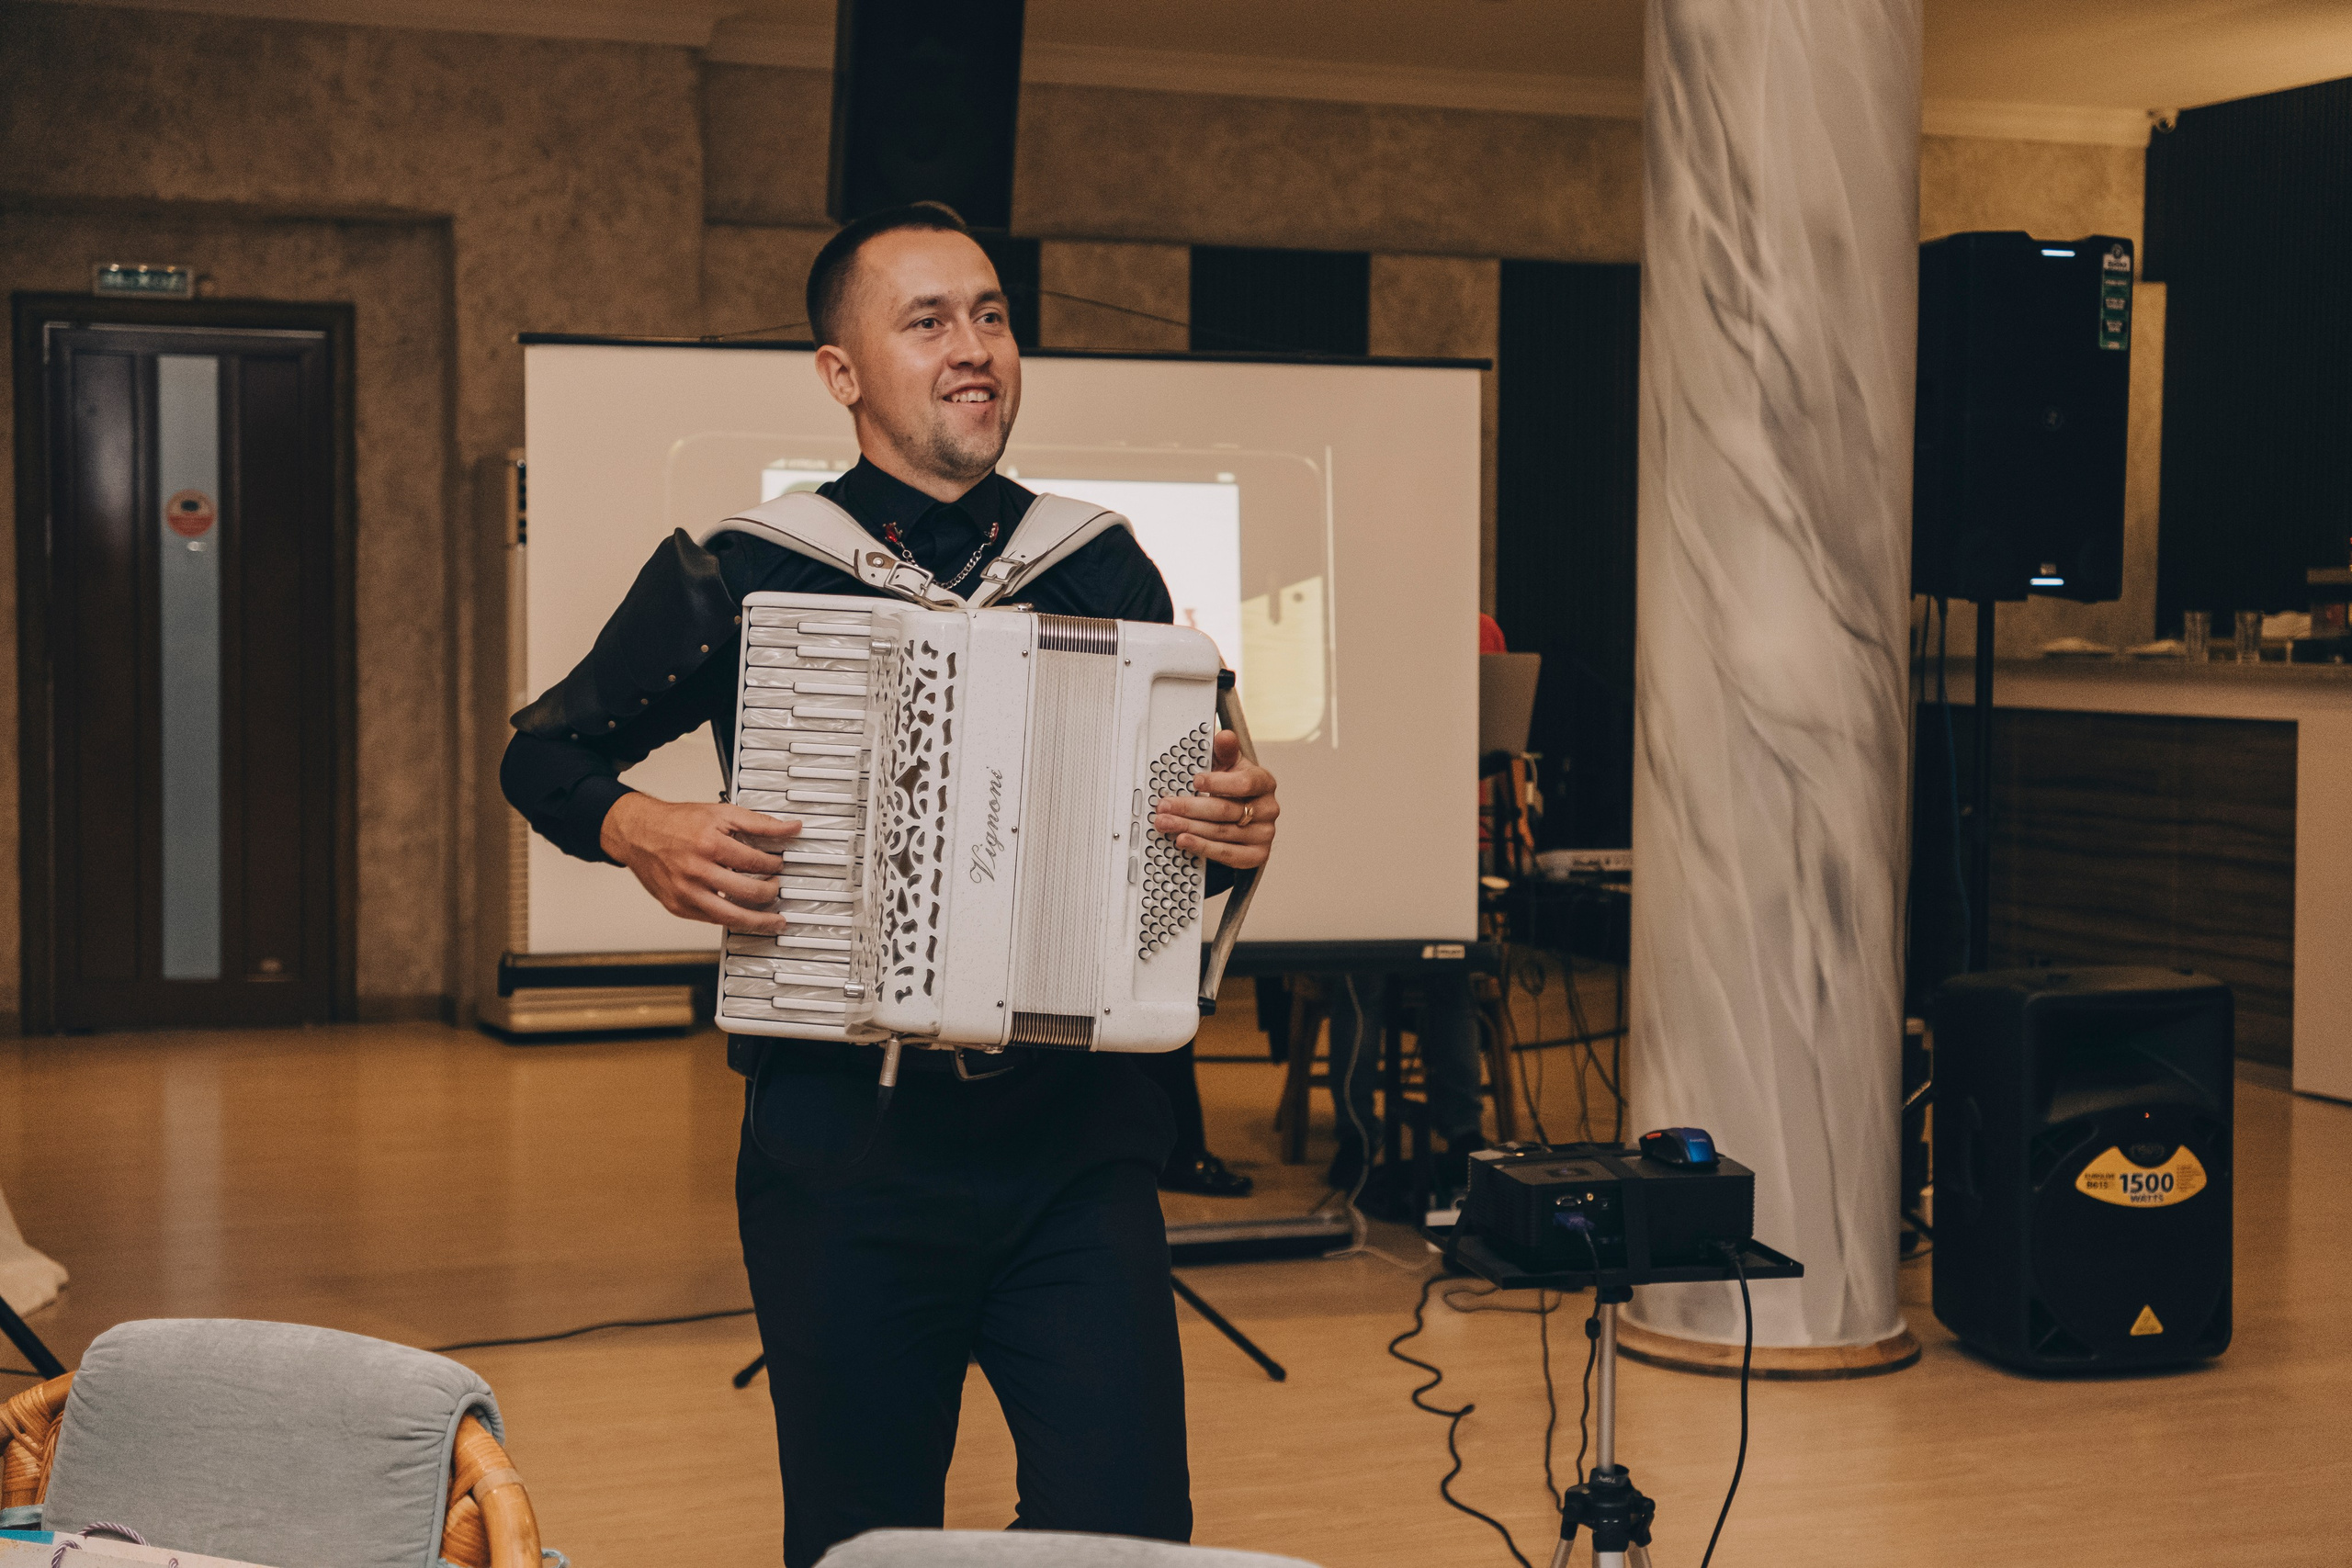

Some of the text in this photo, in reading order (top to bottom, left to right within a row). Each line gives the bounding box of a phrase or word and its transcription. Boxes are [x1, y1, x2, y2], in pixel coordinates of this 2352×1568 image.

[970, 766, 1005, 883] Vignoni
[2120, 1172, 2174, 1193] 1500
[2131, 1194, 2165, 1202] WATTS
